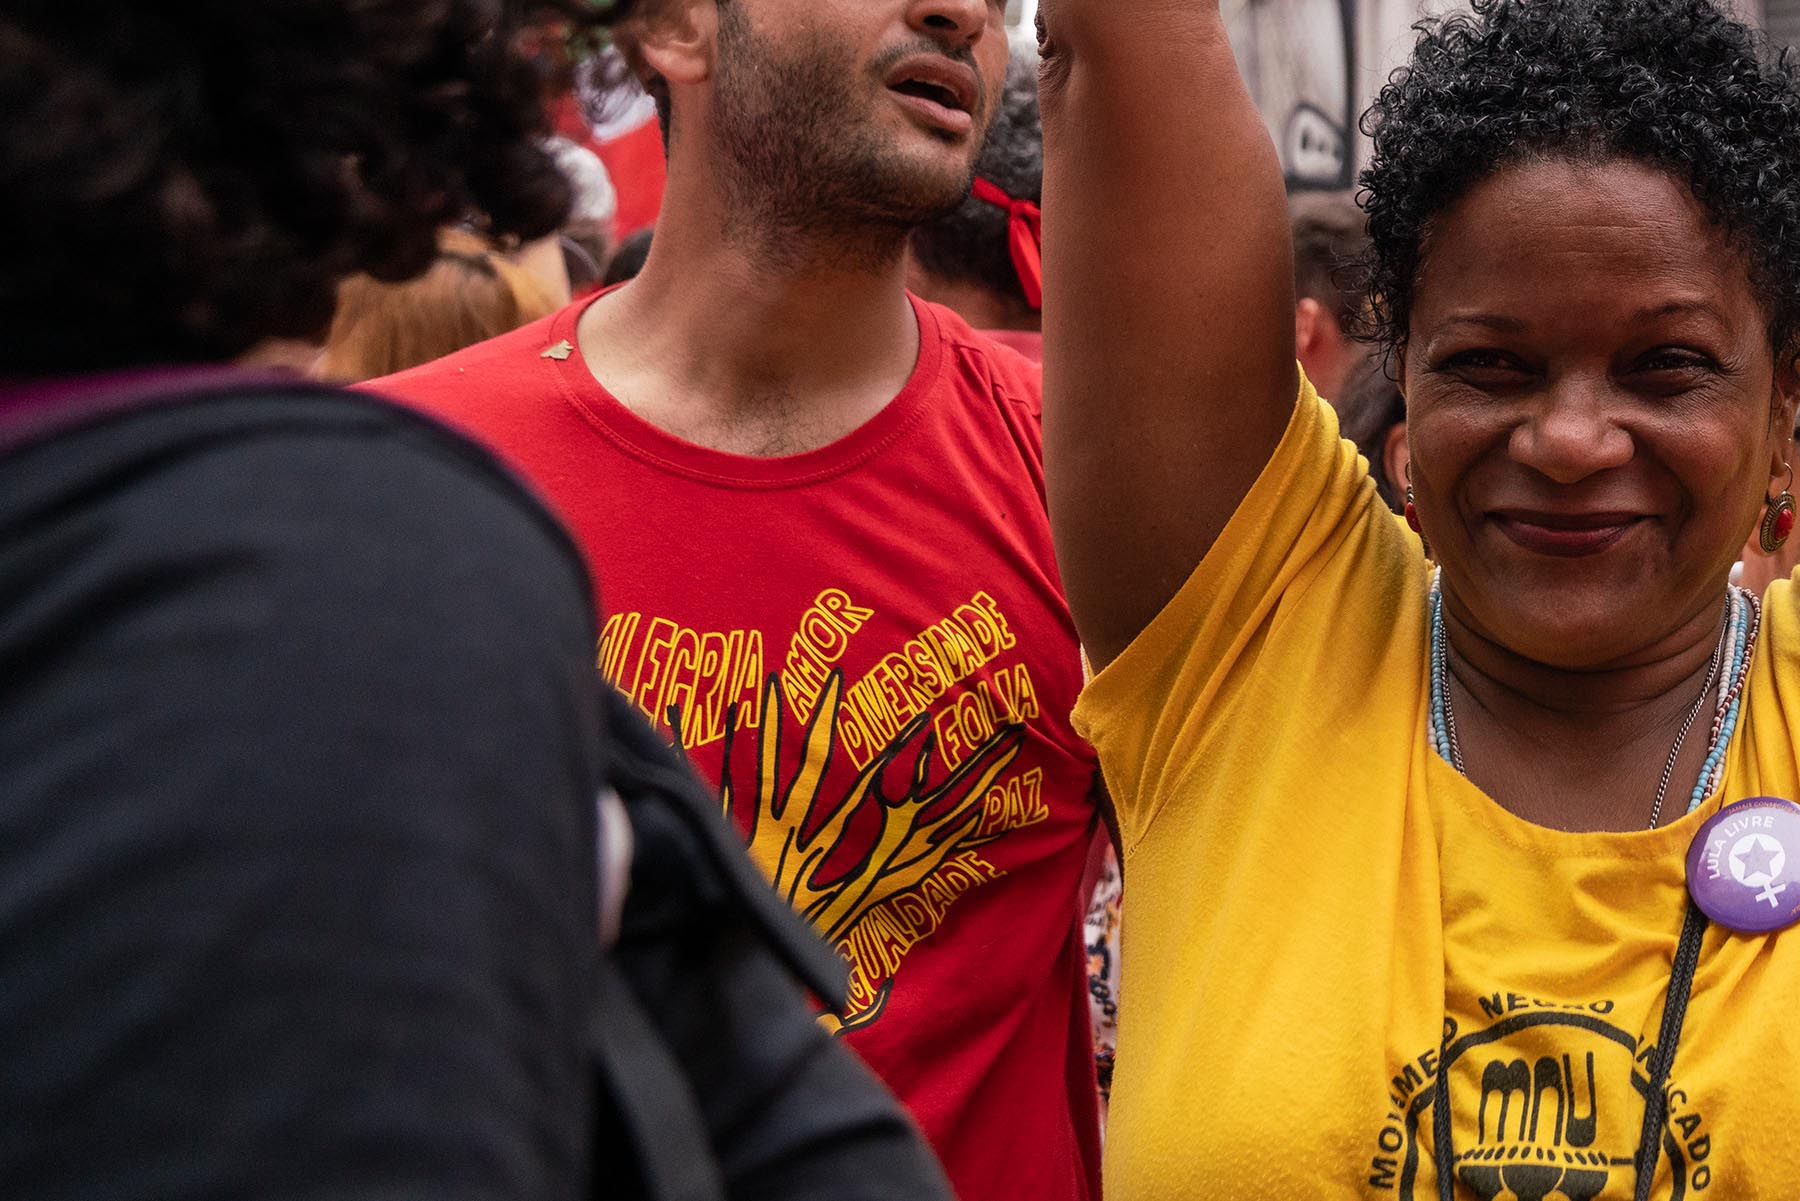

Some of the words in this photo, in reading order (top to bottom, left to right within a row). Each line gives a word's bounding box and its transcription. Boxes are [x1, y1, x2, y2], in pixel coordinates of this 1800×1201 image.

[596, 611, 763, 750] ALEGRIA
[781, 587, 875, 726] AMOR
[836, 590, 1017, 772] DIVERSIDADE
[933, 662, 1040, 772] FOLIA
[976, 766, 1049, 838] PAZ
[1706, 839, 1727, 880] LULA
[1724, 814, 1775, 838] LIVRE
[1478, 991, 1615, 1020] NEO
